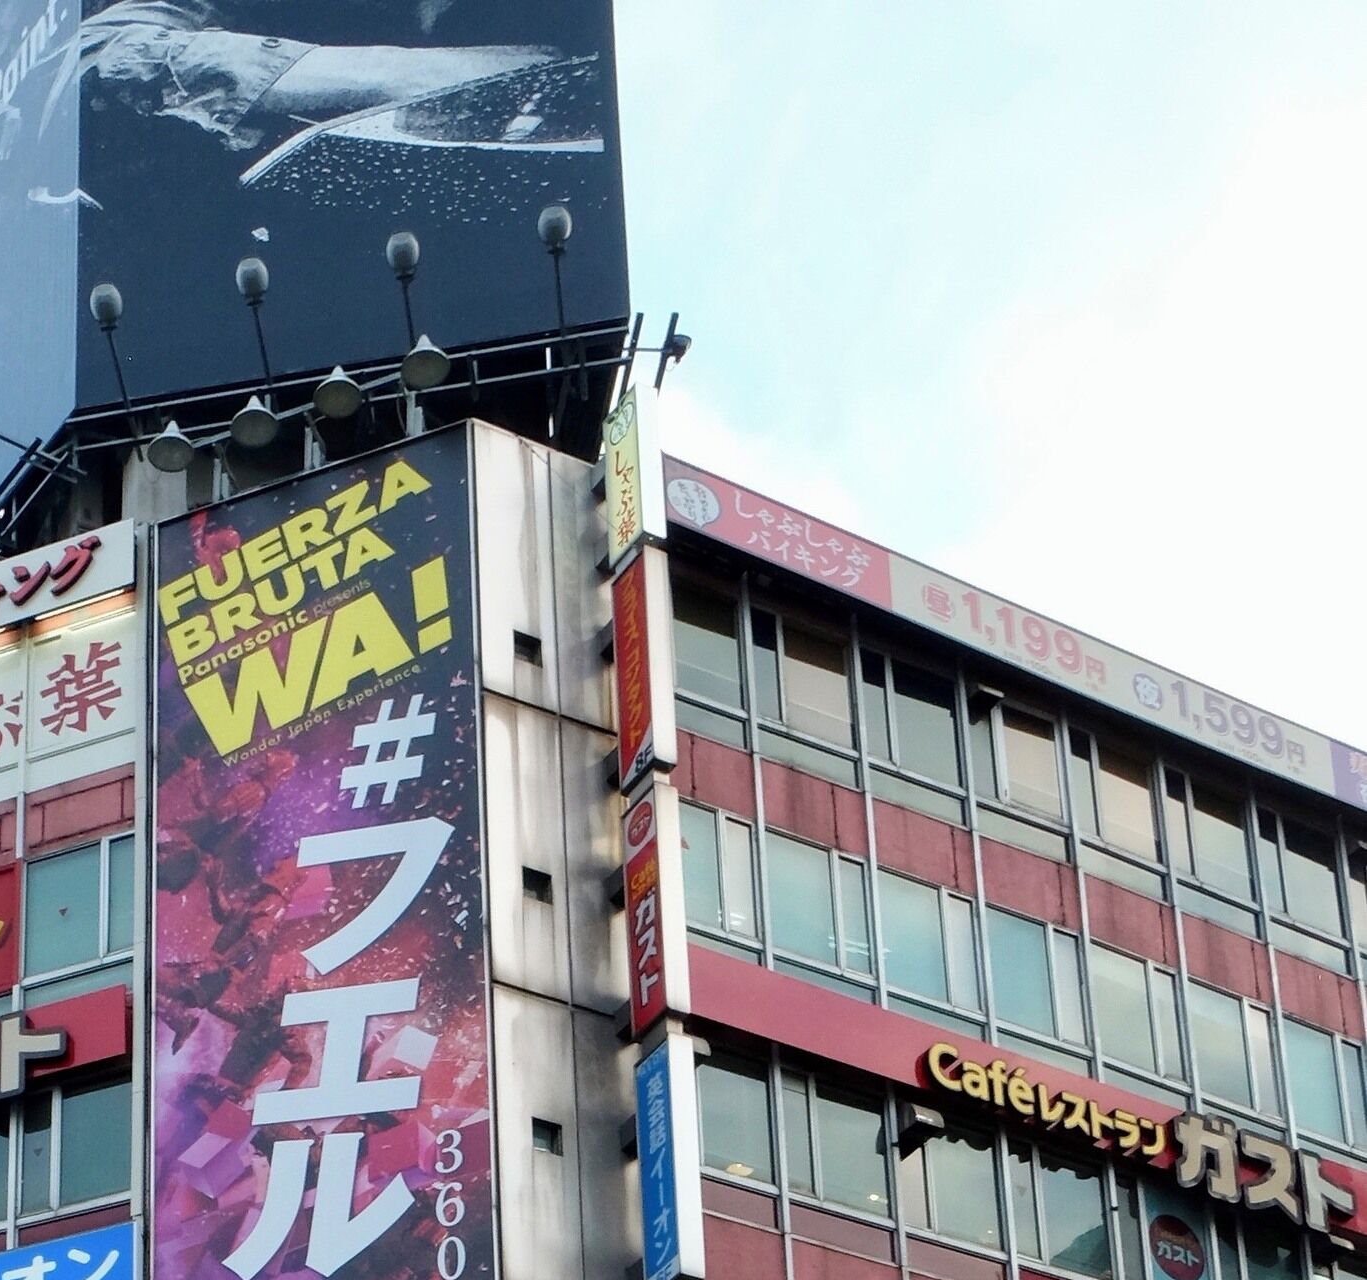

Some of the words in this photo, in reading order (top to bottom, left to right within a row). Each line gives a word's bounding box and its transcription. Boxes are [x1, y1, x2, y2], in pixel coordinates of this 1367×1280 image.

[157, 460, 433, 627] FUERZA
[733, 489, 873, 569] しゃぶしゃぶ
[746, 530, 865, 588] バイキング
[167, 526, 396, 667] BRUTA
[178, 609, 309, 686] Panasonic
[312, 577, 372, 618] presents
[962, 590, 1107, 687] 1,199円
[183, 555, 454, 757] WA!
[222, 732, 283, 768] Wonder
[288, 707, 333, 741] Japan
[336, 665, 422, 711] Experience
[1170, 680, 1307, 764] 1,599円
[634, 890, 659, 1007] ガスト
[645, 1071, 675, 1267] 英会話イーオン
[928, 1041, 1166, 1157] Caféレストラン
[1177, 1114, 1355, 1232] ガスト
[1156, 1240, 1200, 1266] ガスト
